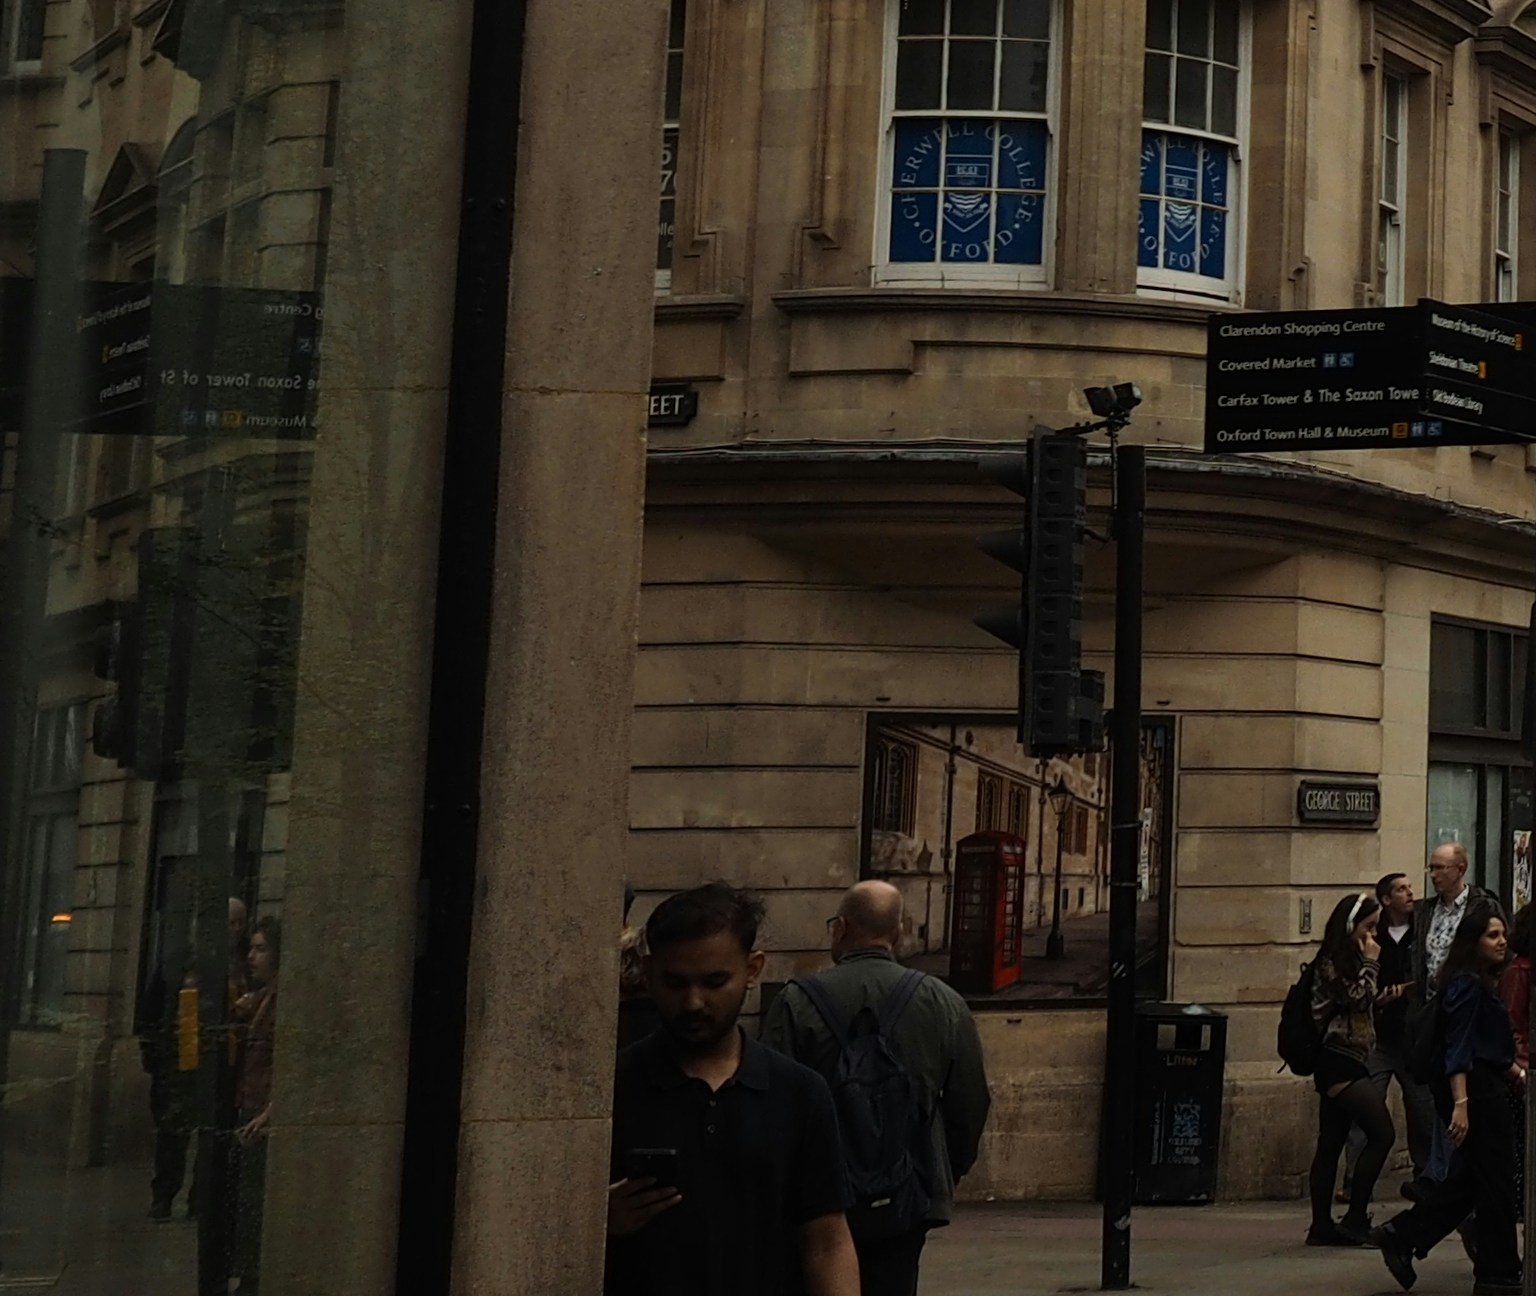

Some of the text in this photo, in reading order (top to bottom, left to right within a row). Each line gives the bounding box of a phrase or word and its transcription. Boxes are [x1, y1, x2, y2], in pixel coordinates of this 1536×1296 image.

[919, 228, 1013, 258] OFOD
[1144, 236, 1210, 268] OFOD
[1219, 319, 1386, 337] Clarendon Shopping Centre
[1218, 356, 1317, 372] Covered Market
[650, 394, 684, 415] EET
[1217, 386, 1420, 408] Carfax Tower & The Saxon Towe
[1216, 425, 1390, 443] Oxford Town Hall & Museum
[1305, 790, 1376, 811] GEORGE STREET
